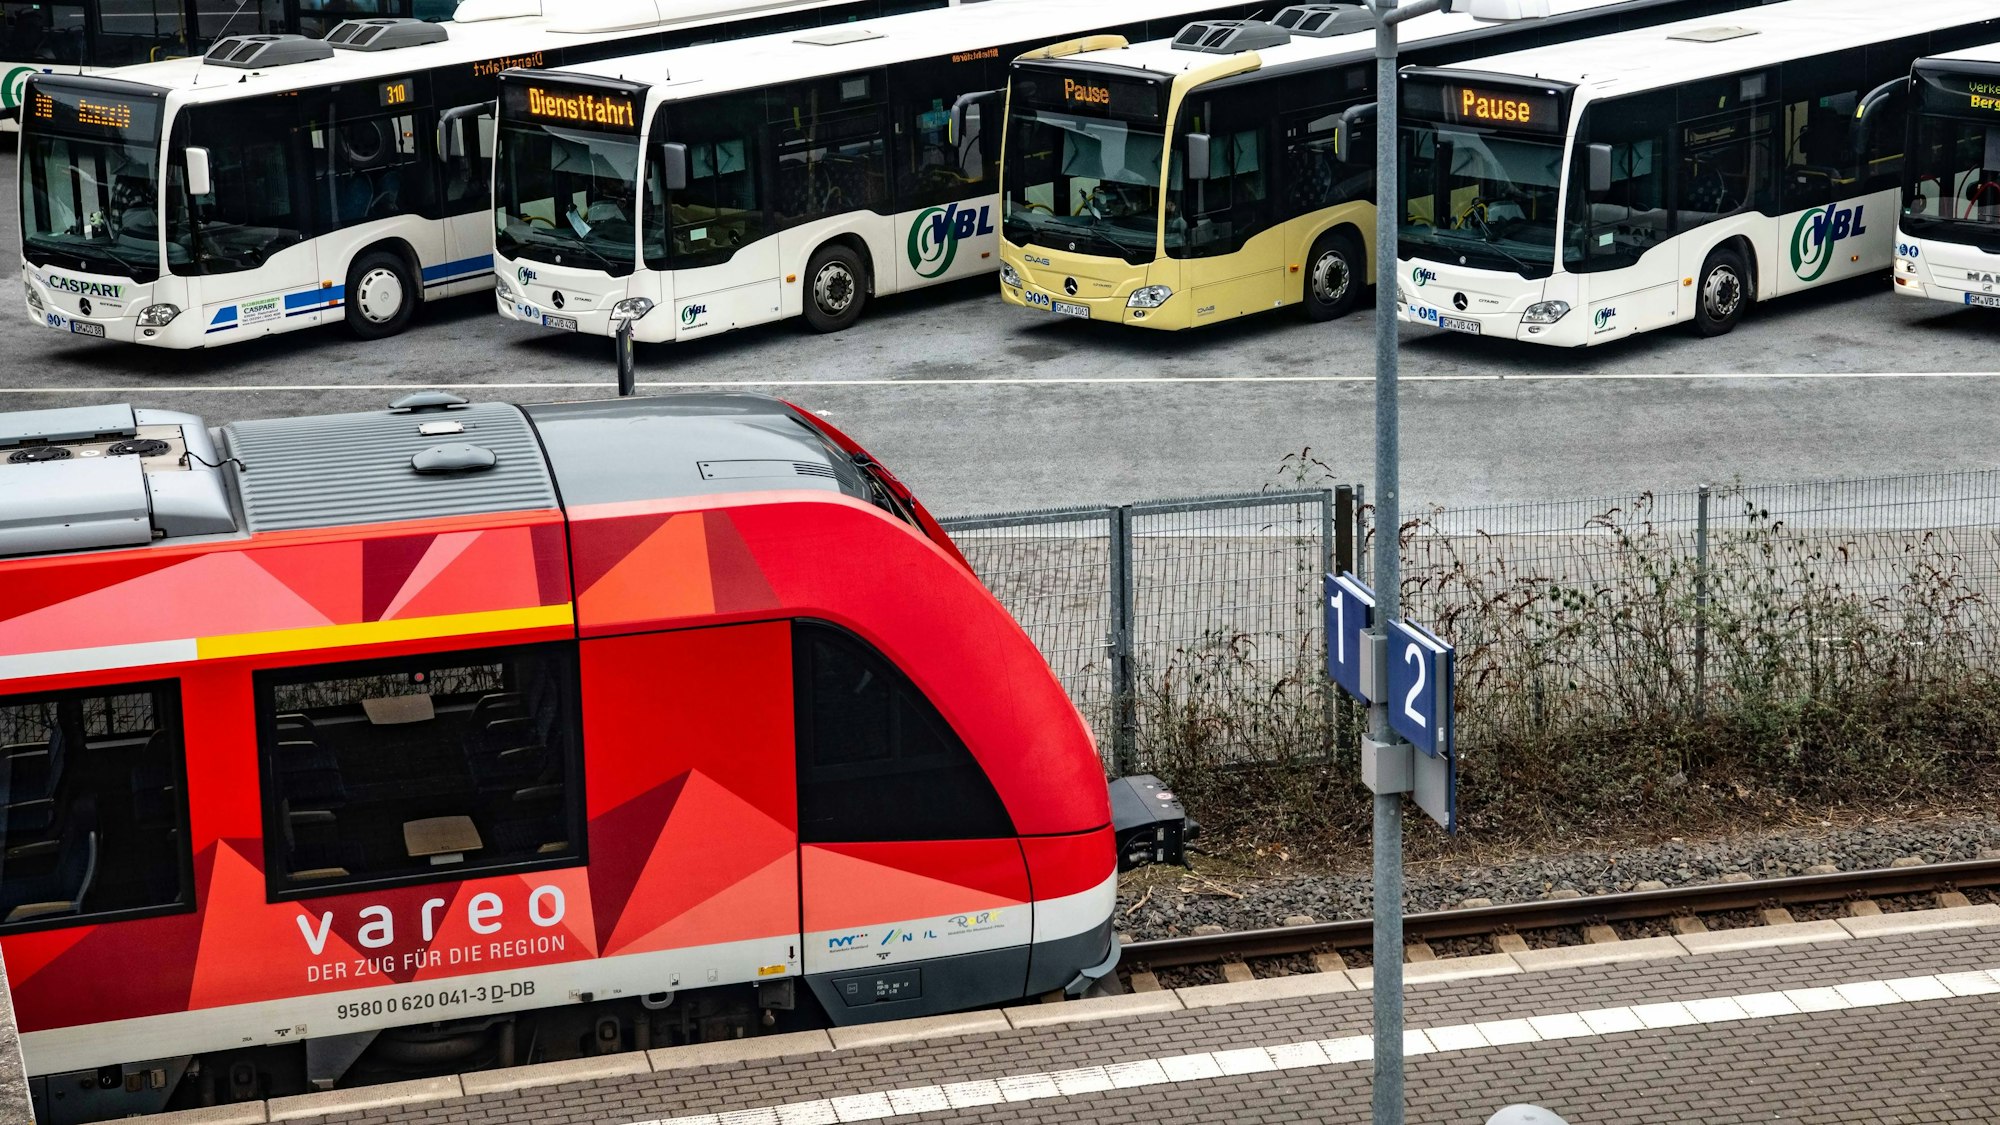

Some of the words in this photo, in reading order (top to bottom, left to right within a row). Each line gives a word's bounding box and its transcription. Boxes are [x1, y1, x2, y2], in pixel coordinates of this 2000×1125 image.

[387, 84, 405, 104] 310
[529, 87, 635, 127] Dienstfahrt
[1064, 78, 1110, 104] Pause
[1462, 89, 1530, 123] Pause
[932, 203, 994, 244] VBL
[1813, 203, 1867, 247] VBL
[49, 274, 120, 298] CASPARI
[1970, 295, 1980, 304] GM
[243, 303, 275, 314] CASPARI
[1466, 321, 1479, 332] 417
[1331, 590, 1345, 664] 1
[1404, 642, 1426, 728] 2
[296, 884, 566, 956] vareo
[307, 962, 347, 983] DER
[355, 956, 395, 977] ZUG
[403, 949, 441, 970] FÜR
[450, 944, 482, 965] DIE
[490, 935, 566, 959] REGION
[337, 1000, 383, 1020] 9580
[387, 998, 398, 1014] 0
[402, 993, 435, 1012] 620
[440, 986, 487, 1007] 041-3
[491, 981, 535, 1004] D-DB
